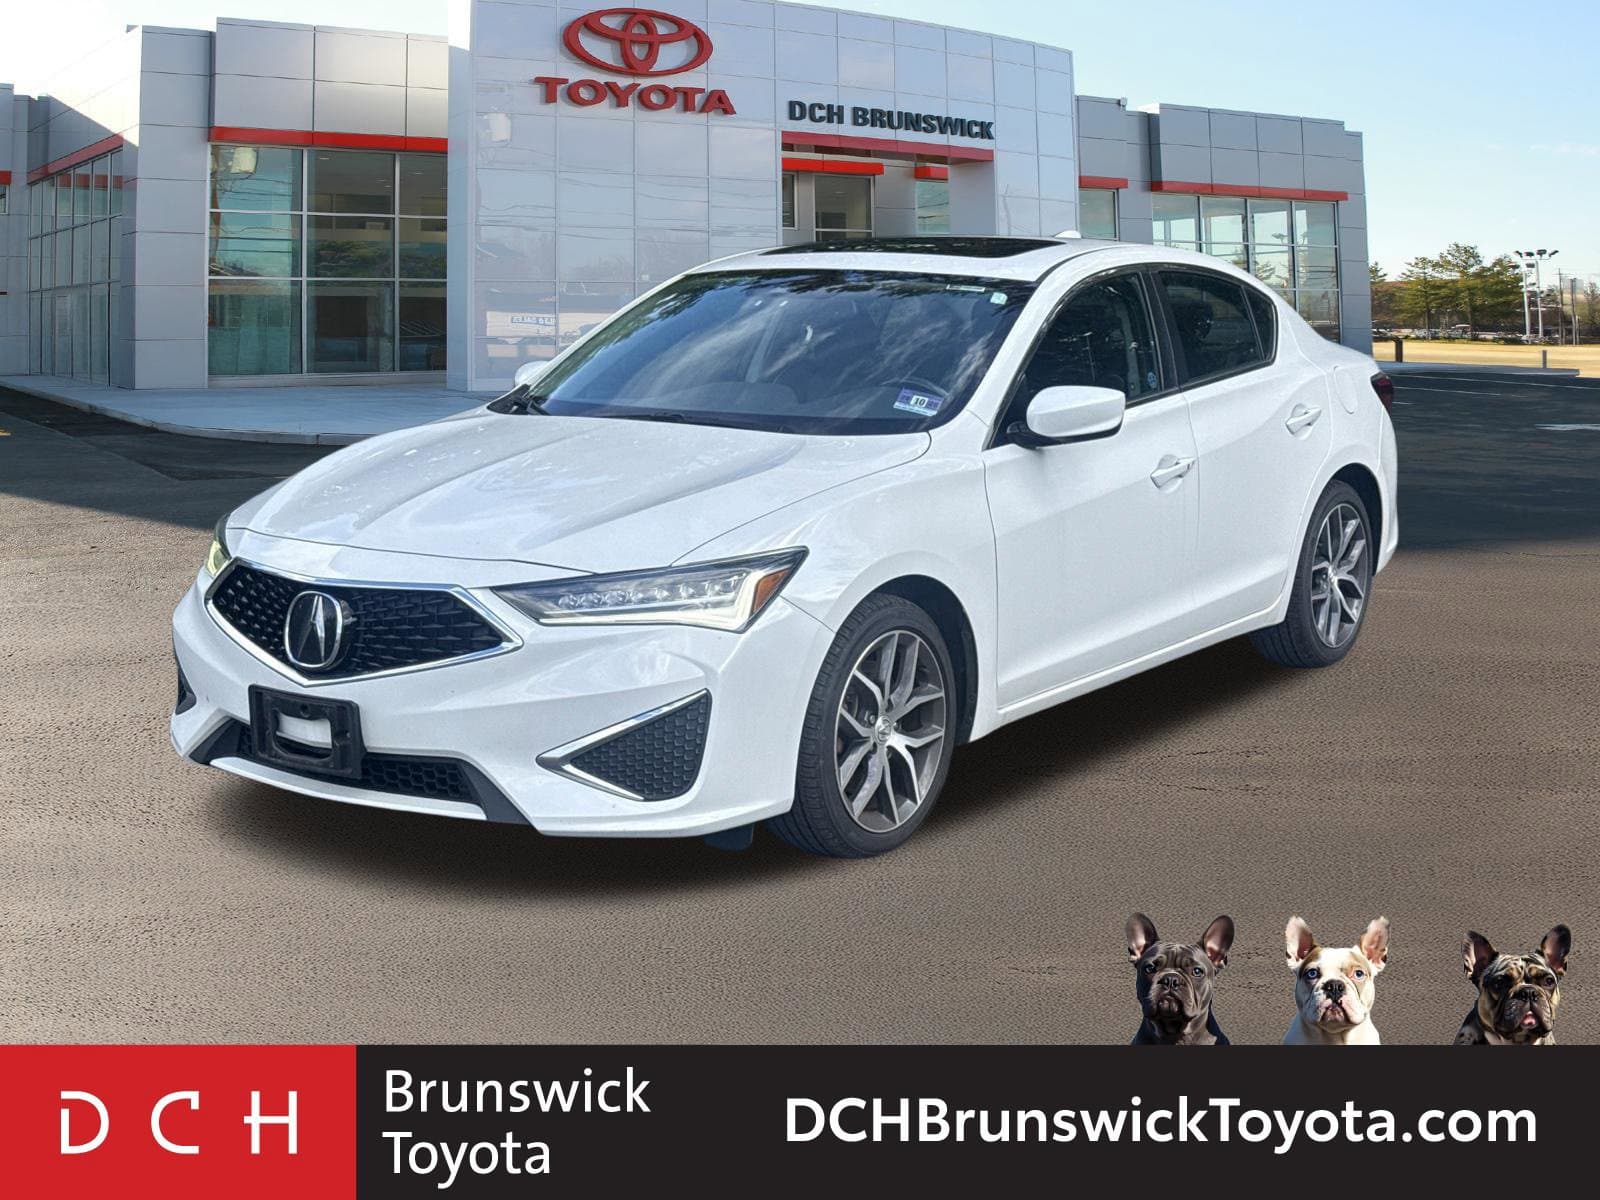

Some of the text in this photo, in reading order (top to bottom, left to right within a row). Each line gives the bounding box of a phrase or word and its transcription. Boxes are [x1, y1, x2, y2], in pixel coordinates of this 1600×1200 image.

[534, 76, 736, 115] TOYOTA
[788, 100, 995, 140] DCH BRUNSWICK
[914, 397, 926, 407] 10
